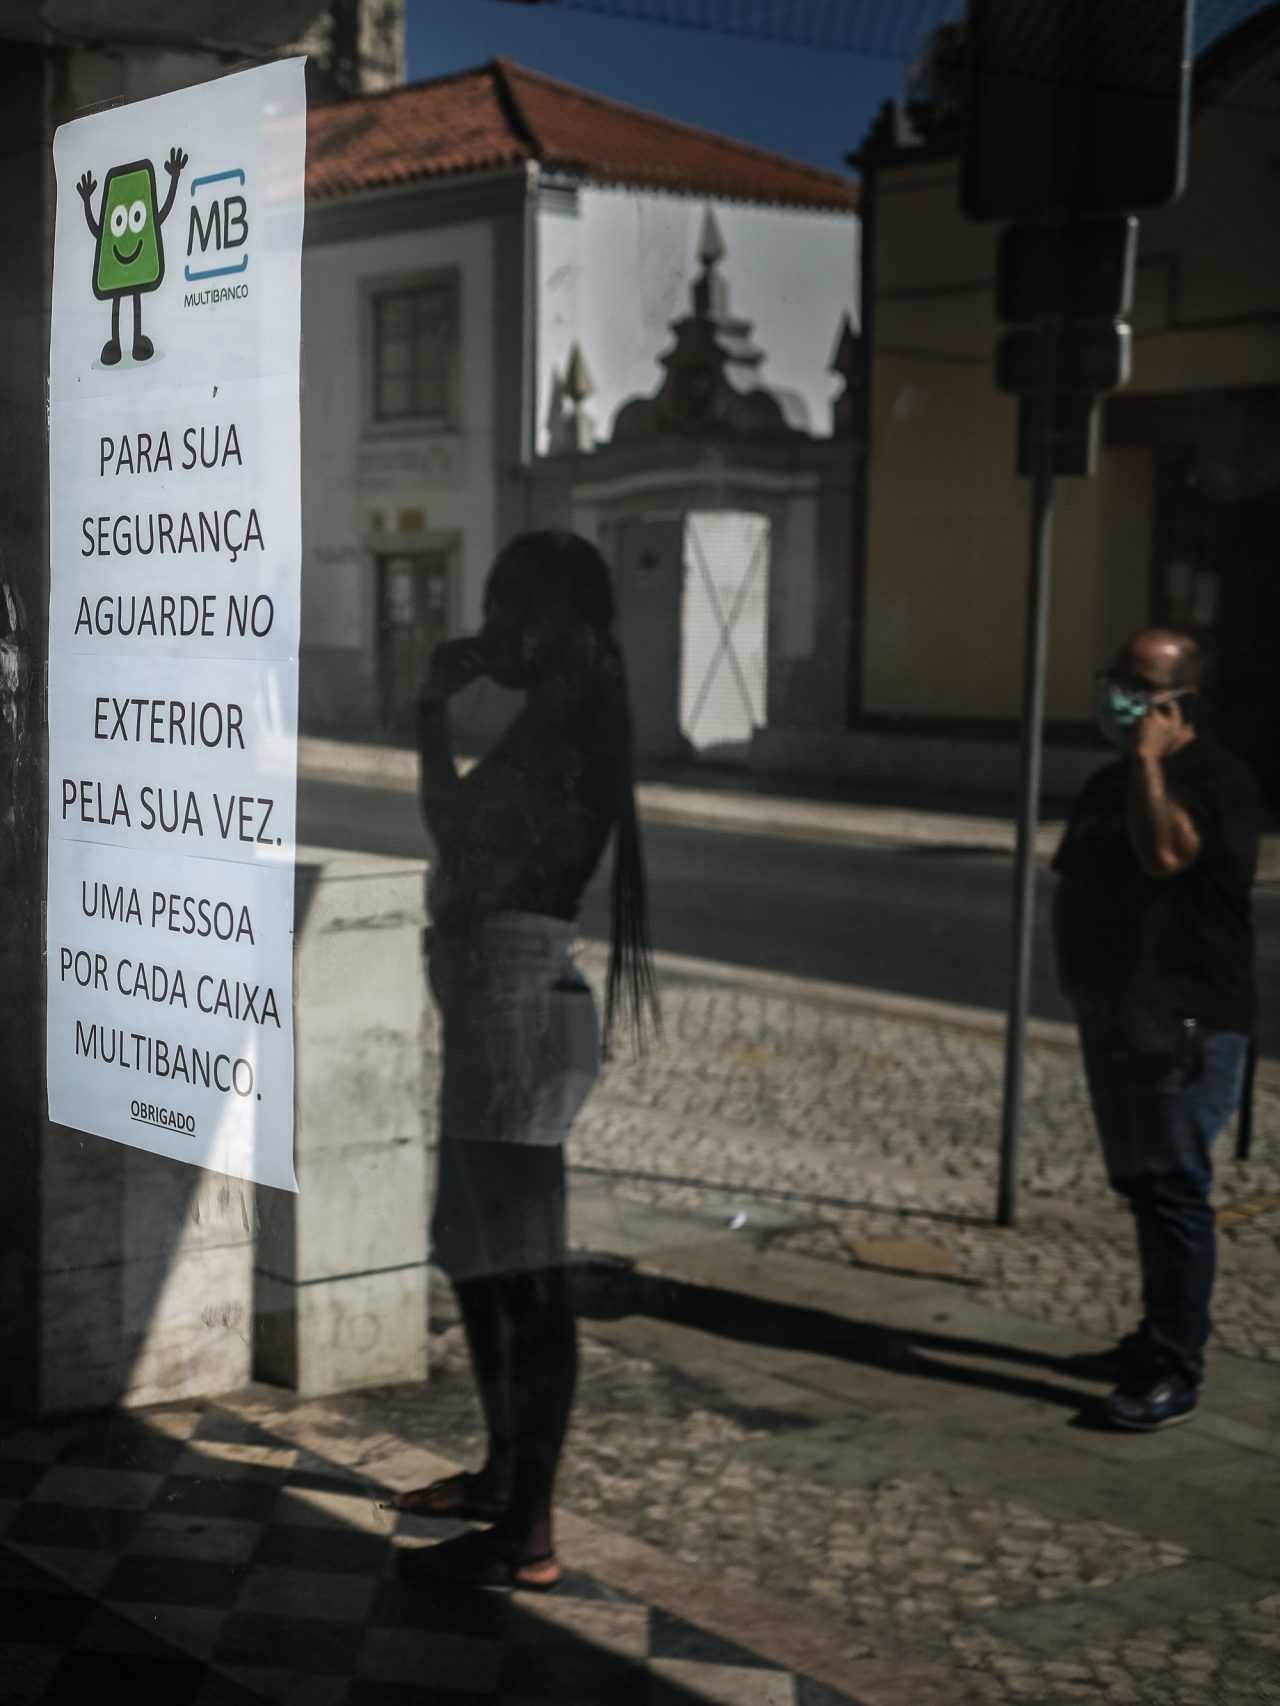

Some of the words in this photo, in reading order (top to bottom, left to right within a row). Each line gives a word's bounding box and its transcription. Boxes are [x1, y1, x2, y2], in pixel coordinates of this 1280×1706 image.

[187, 196, 248, 256] MB
[184, 284, 248, 308] MULTIBANCO
[100, 430, 173, 476] PARA
[183, 424, 242, 470] SUA
[82, 508, 265, 562] SEGURANÇA
[75, 596, 216, 636] AGUARDE
[228, 595, 274, 637] NO
[95, 697, 245, 749] EXTERIOR
[63, 779, 130, 828] PELA
[140, 787, 203, 836] SUA
[213, 794, 282, 845] VEZ.
[83, 881, 142, 925] UMA
[152, 891, 254, 945] PESSOA
[61, 948, 108, 991] POR
[117, 959, 187, 1008] CADA
[197, 975, 281, 1028] CAIXA
[75, 1021, 262, 1101] MULTIBANCO.
[131, 1100, 195, 1133] OBRIGADO
